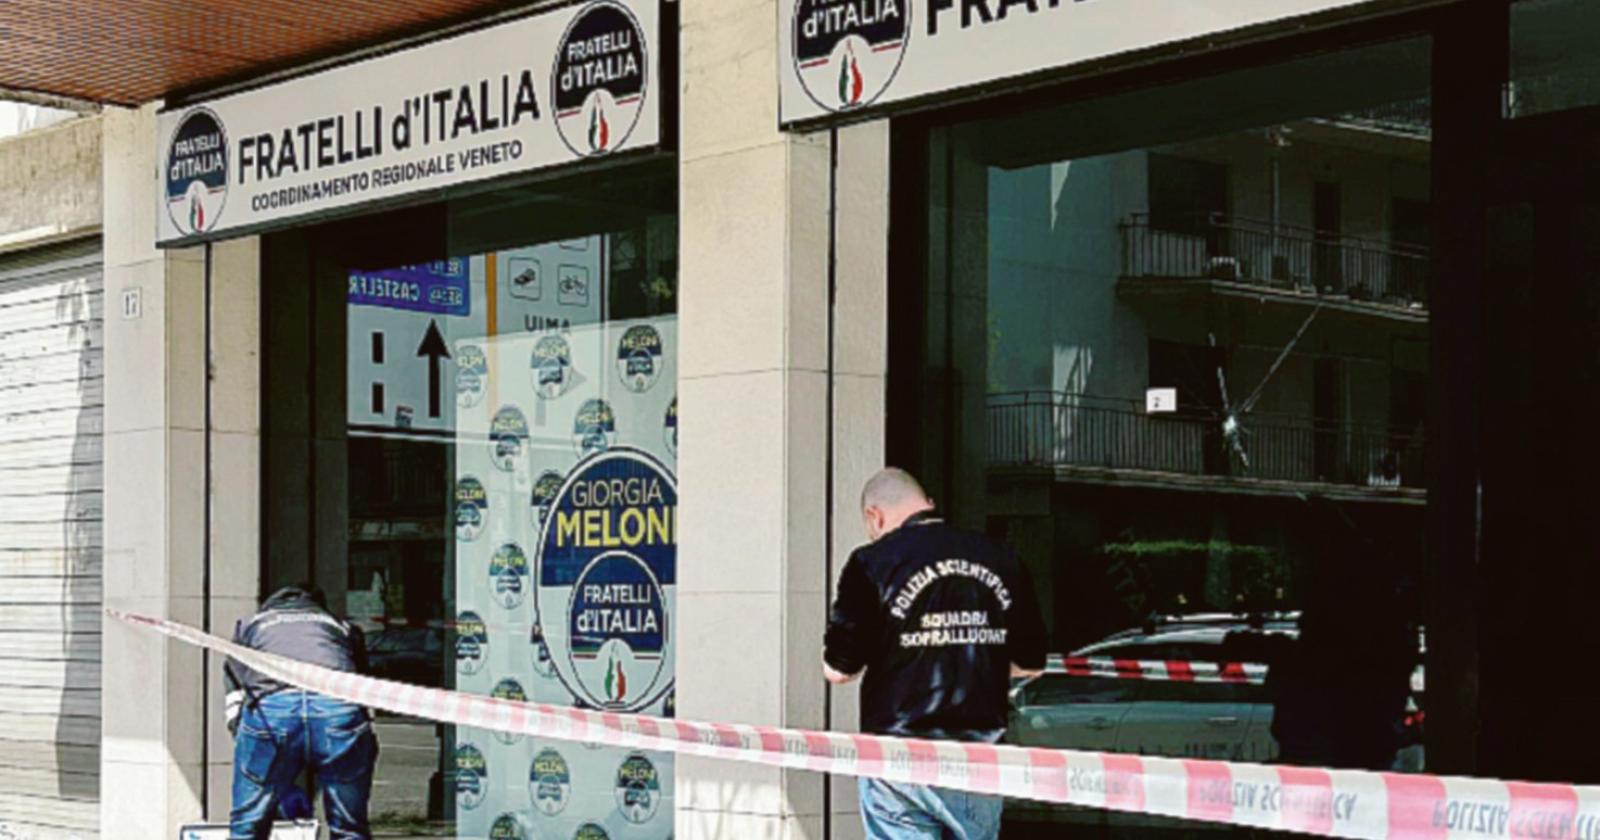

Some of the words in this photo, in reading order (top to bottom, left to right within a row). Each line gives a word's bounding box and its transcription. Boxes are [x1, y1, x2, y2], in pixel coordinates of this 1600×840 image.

[802, 0, 899, 38] d'ITALIA
[567, 30, 632, 62] FRATELLI
[560, 52, 639, 91] d'ITALIA
[239, 106, 382, 185] FRATELLI
[391, 69, 541, 151] d'ITALIA
[175, 132, 220, 158] FRATELLI
[171, 152, 225, 181] d'ITALIA
[251, 171, 370, 212] COORDINAMENTO
[371, 151, 456, 189] REGIONALE
[457, 139, 523, 171] VENETO
[572, 478, 664, 507] GIORGIA
[583, 584, 651, 605] FRATELLI
[890, 566, 939, 619] POLIZIA
[577, 608, 659, 633] d'ITALIA
